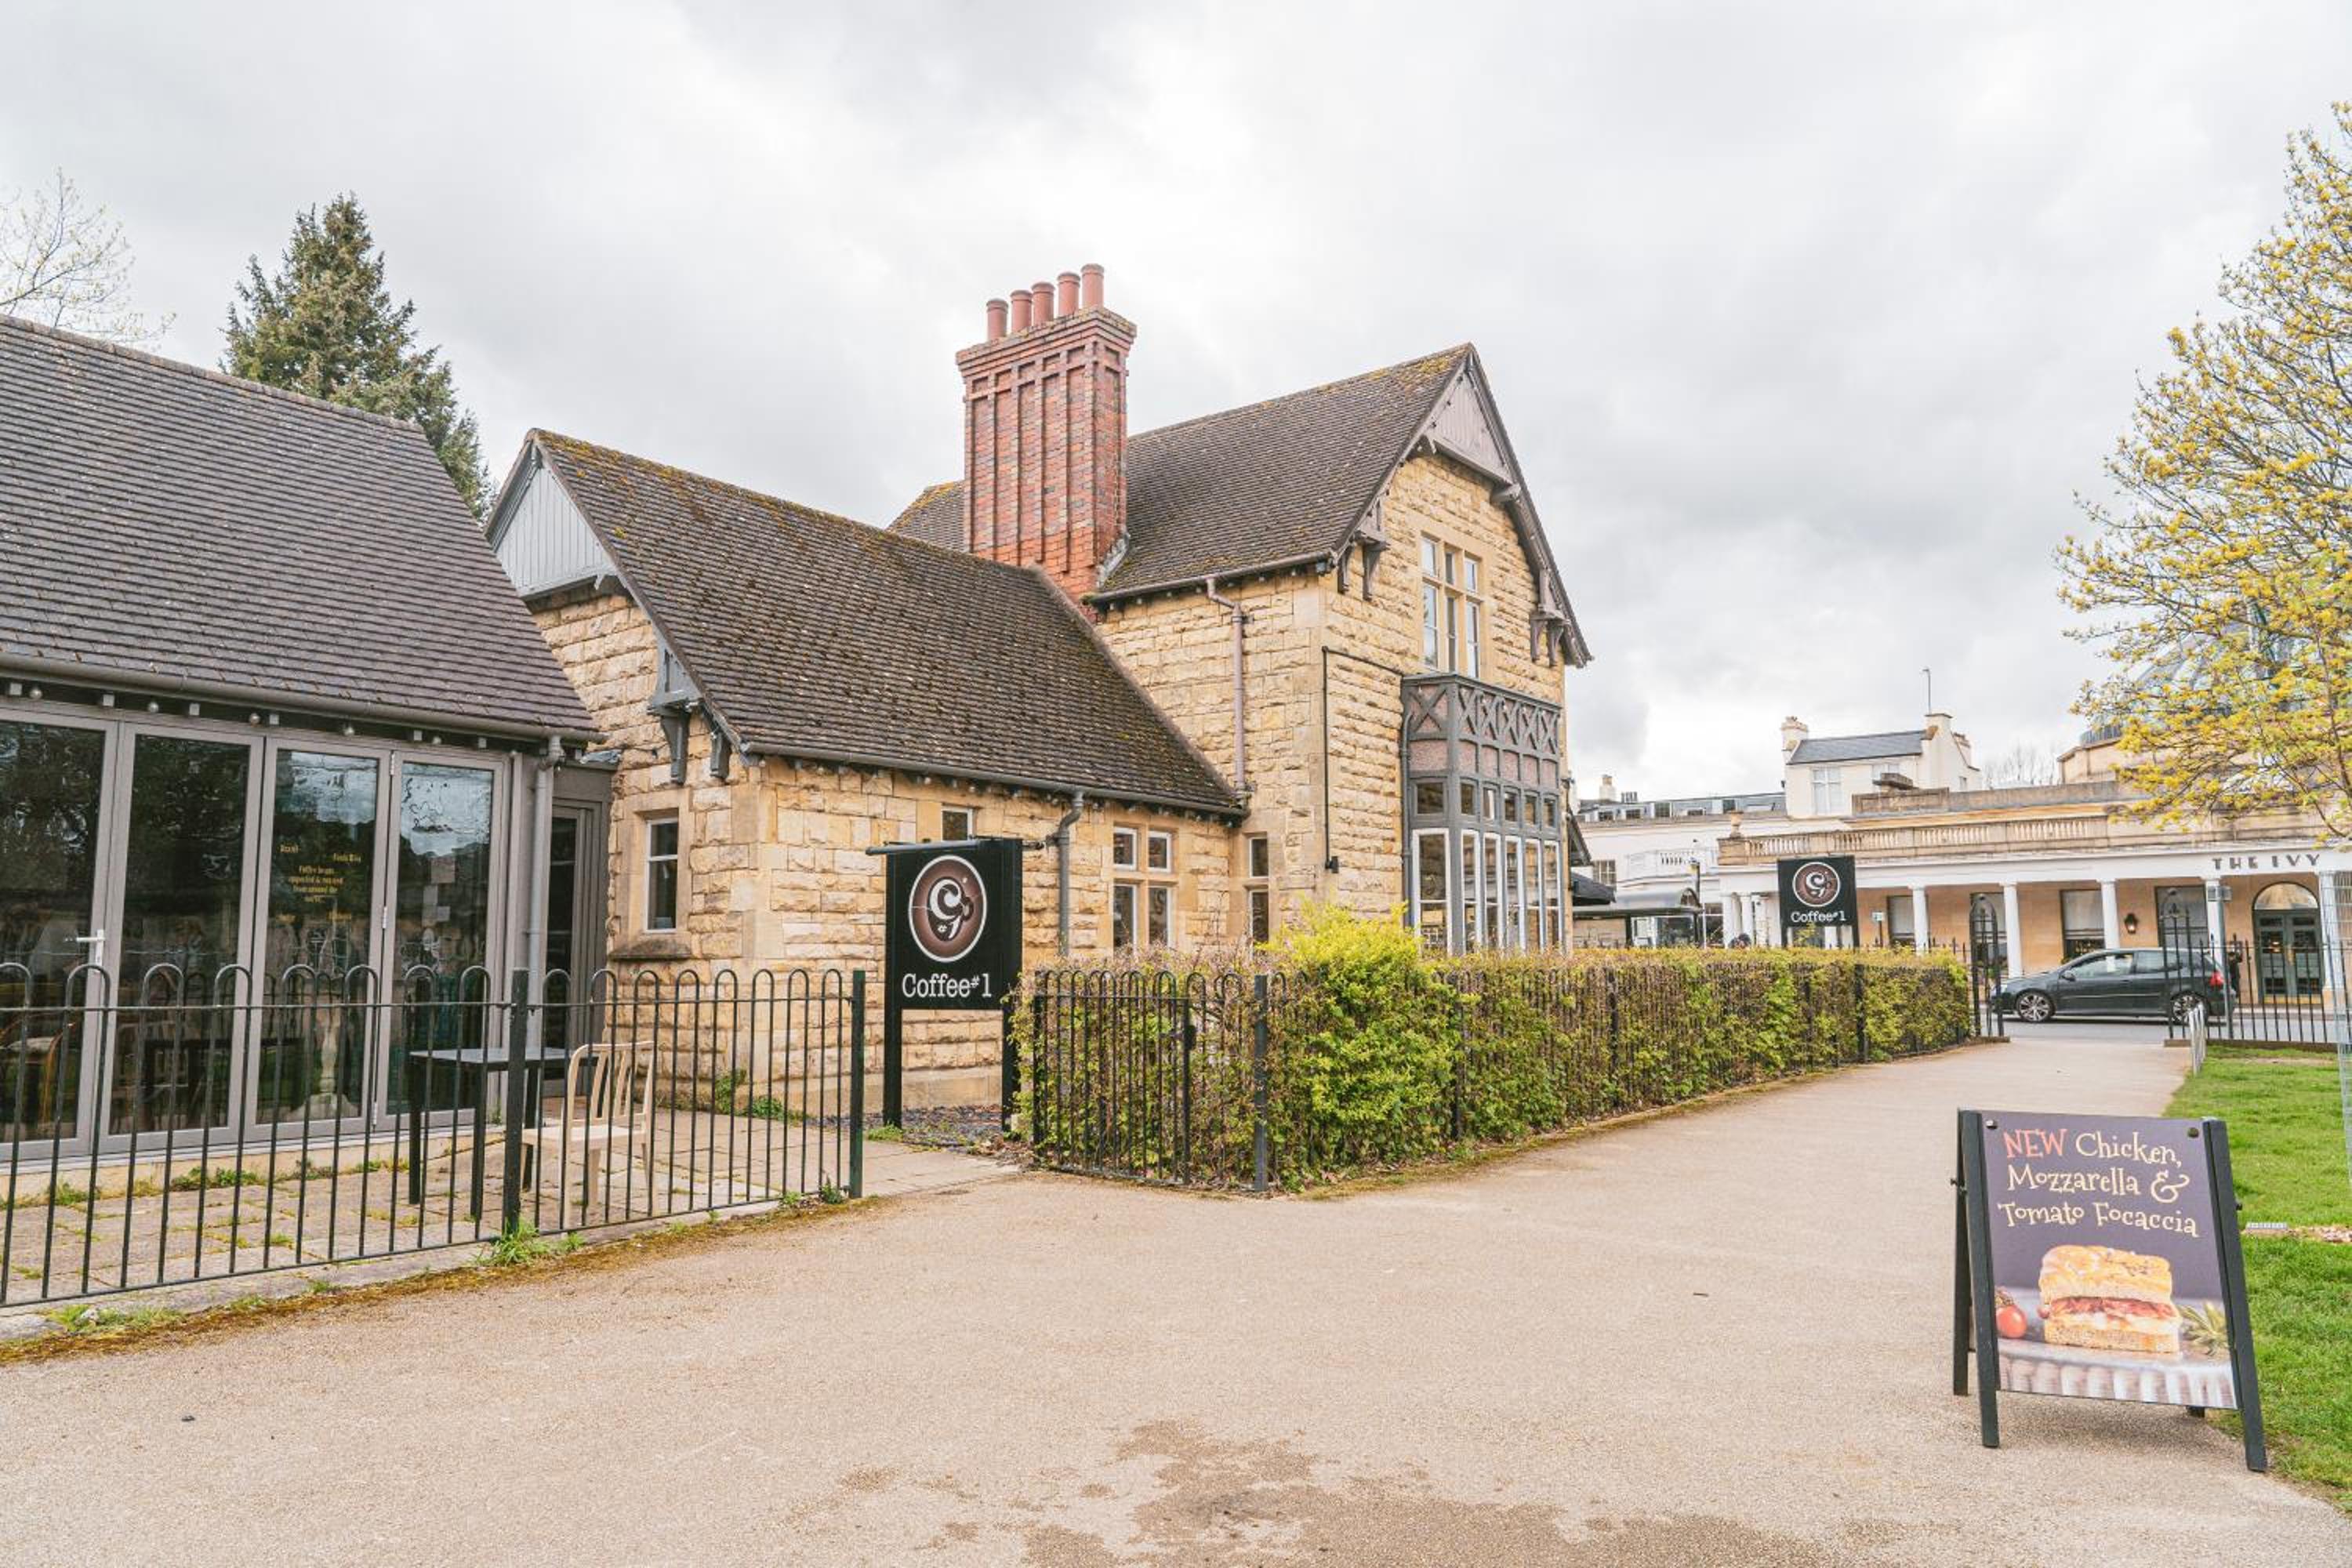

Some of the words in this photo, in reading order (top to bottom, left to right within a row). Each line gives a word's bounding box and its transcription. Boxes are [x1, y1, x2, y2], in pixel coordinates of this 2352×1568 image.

[2212, 855, 2259, 869] THE
[2271, 854, 2321, 868] IVY
[902, 973, 993, 998] Coffee#1
[2004, 1128, 2067, 1158] NEW
[2075, 1131, 2182, 1167] Chicken,
[2007, 1163, 2141, 1196] Mozzarella
[2151, 1170, 2190, 1203] &
[1998, 1201, 2085, 1227] Tomato
[2092, 1202, 2199, 1237] Focaccia
